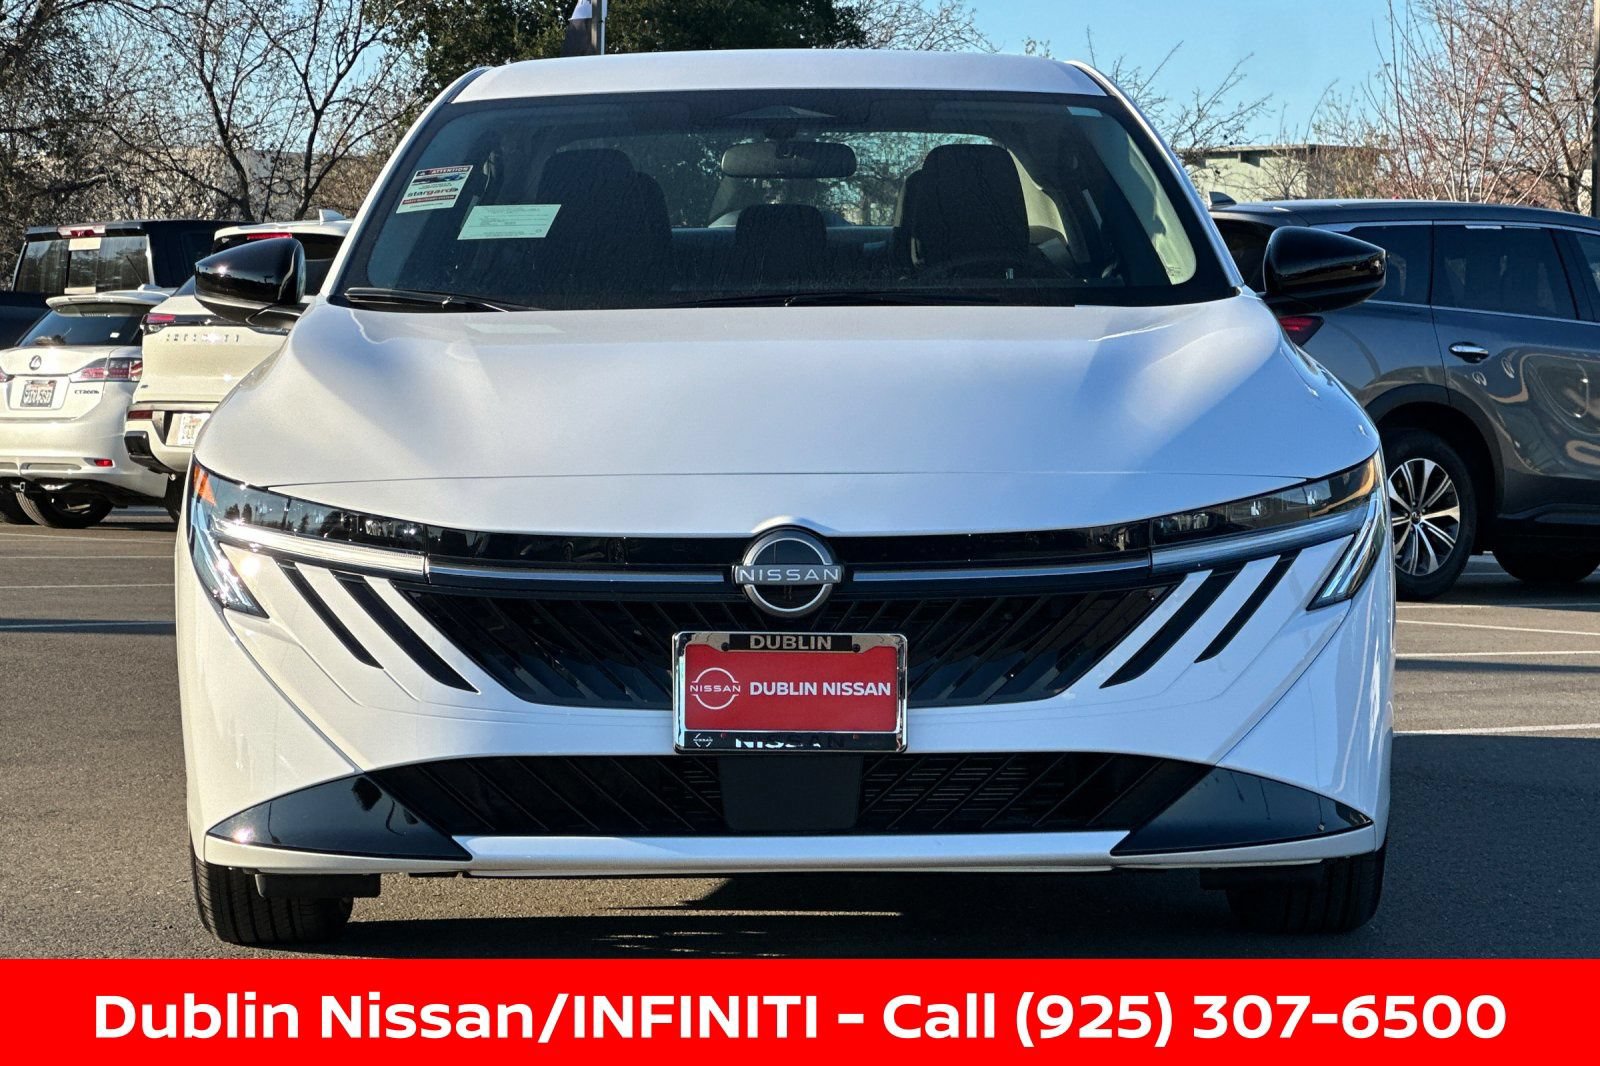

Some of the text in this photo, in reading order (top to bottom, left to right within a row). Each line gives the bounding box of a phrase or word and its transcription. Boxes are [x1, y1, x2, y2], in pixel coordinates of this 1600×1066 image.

[431, 166, 469, 174] ATTENTION
[166, 333, 240, 342] INFITI
[740, 568, 838, 581] NISSAN
[749, 635, 832, 649] DUBLIN
[690, 684, 740, 692] NISSAN
[750, 682, 891, 696] DUBLIN NISSAN
